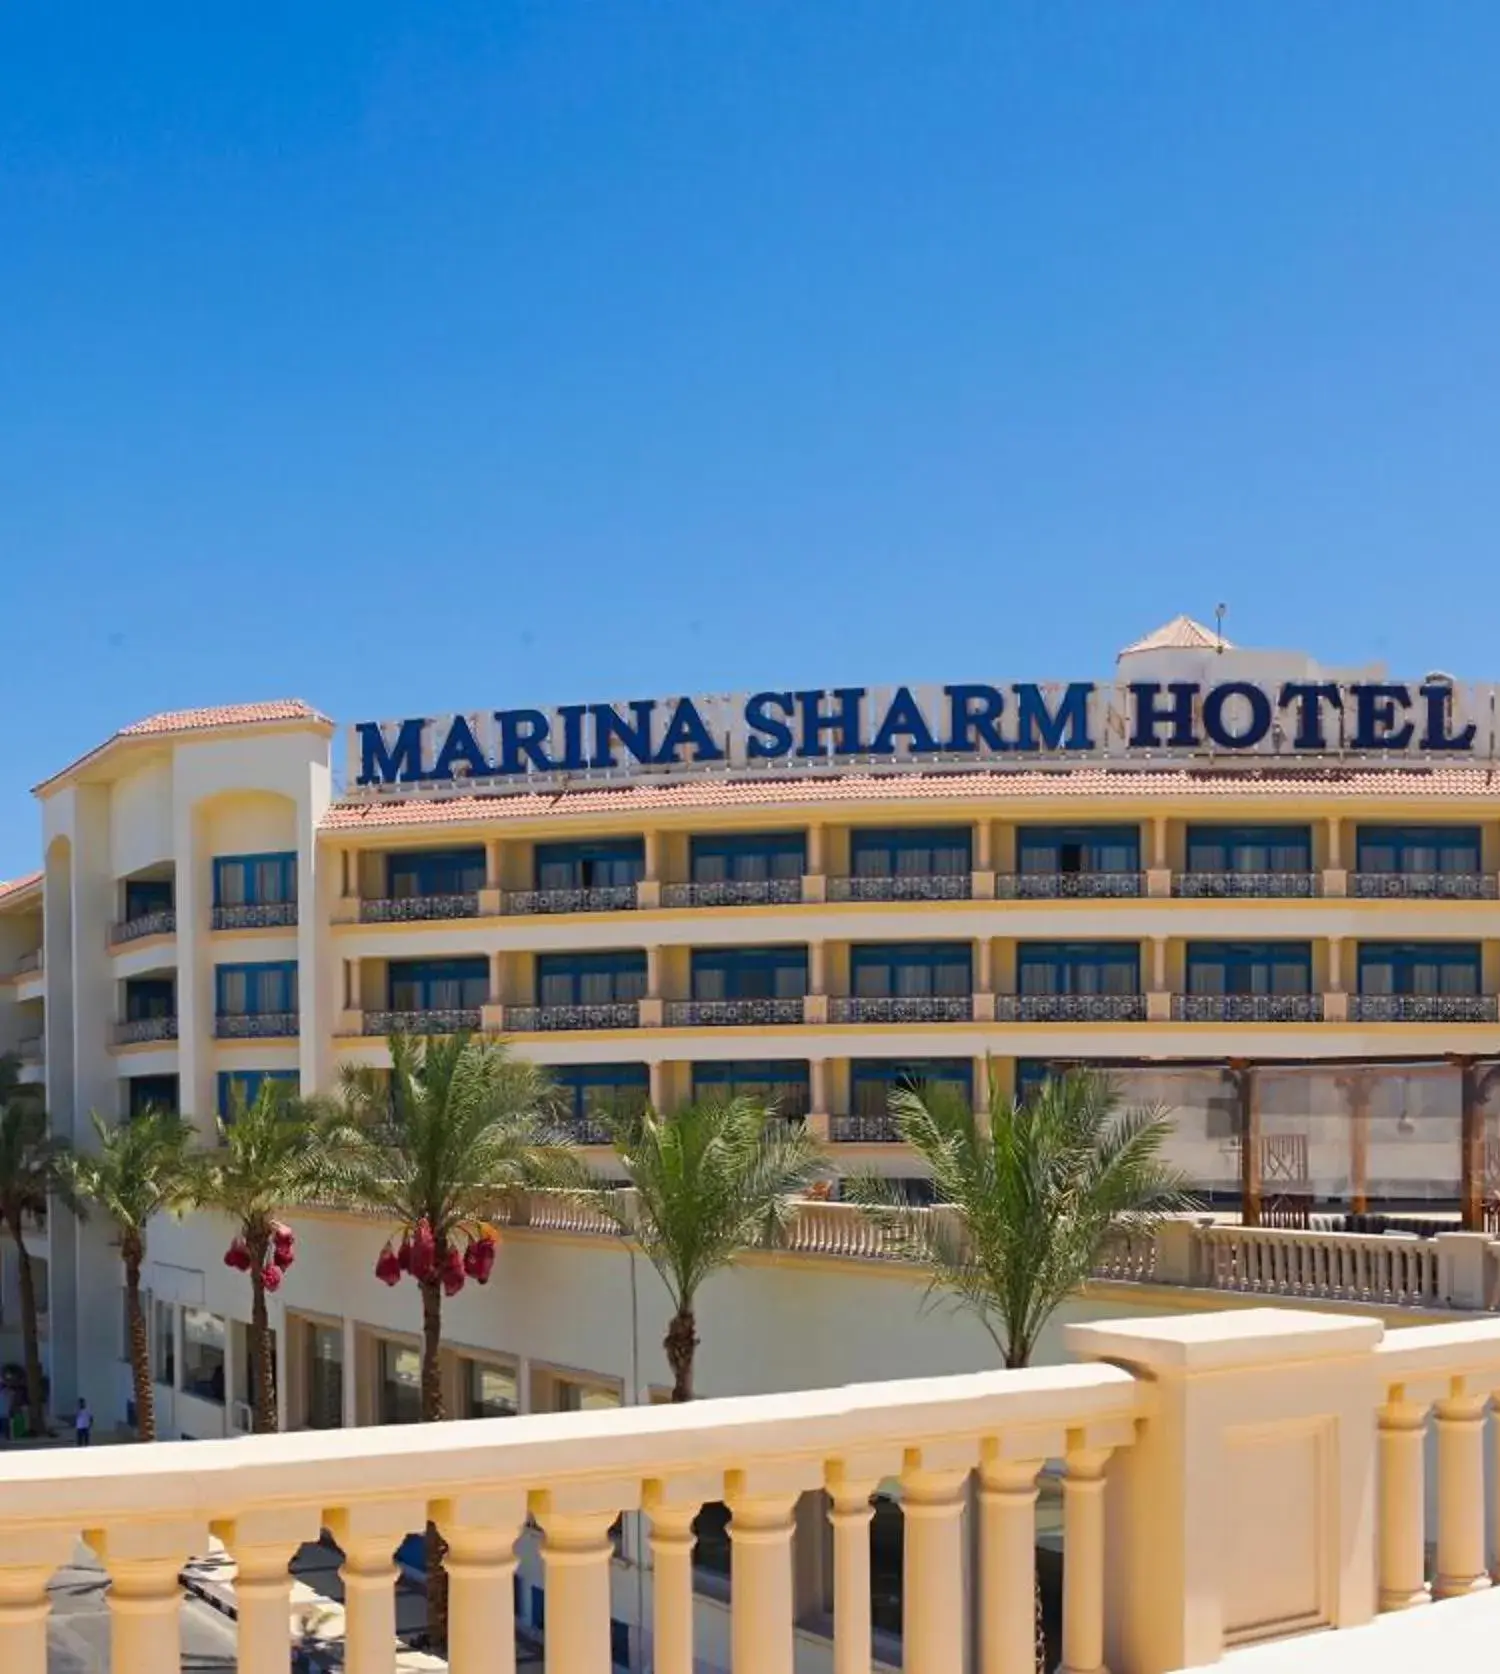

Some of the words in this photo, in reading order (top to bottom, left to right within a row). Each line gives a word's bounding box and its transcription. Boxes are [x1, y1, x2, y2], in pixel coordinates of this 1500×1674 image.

[355, 697, 726, 785] MARINA
[744, 682, 1096, 759] SHARM
[1126, 681, 1477, 751] HOTEL
